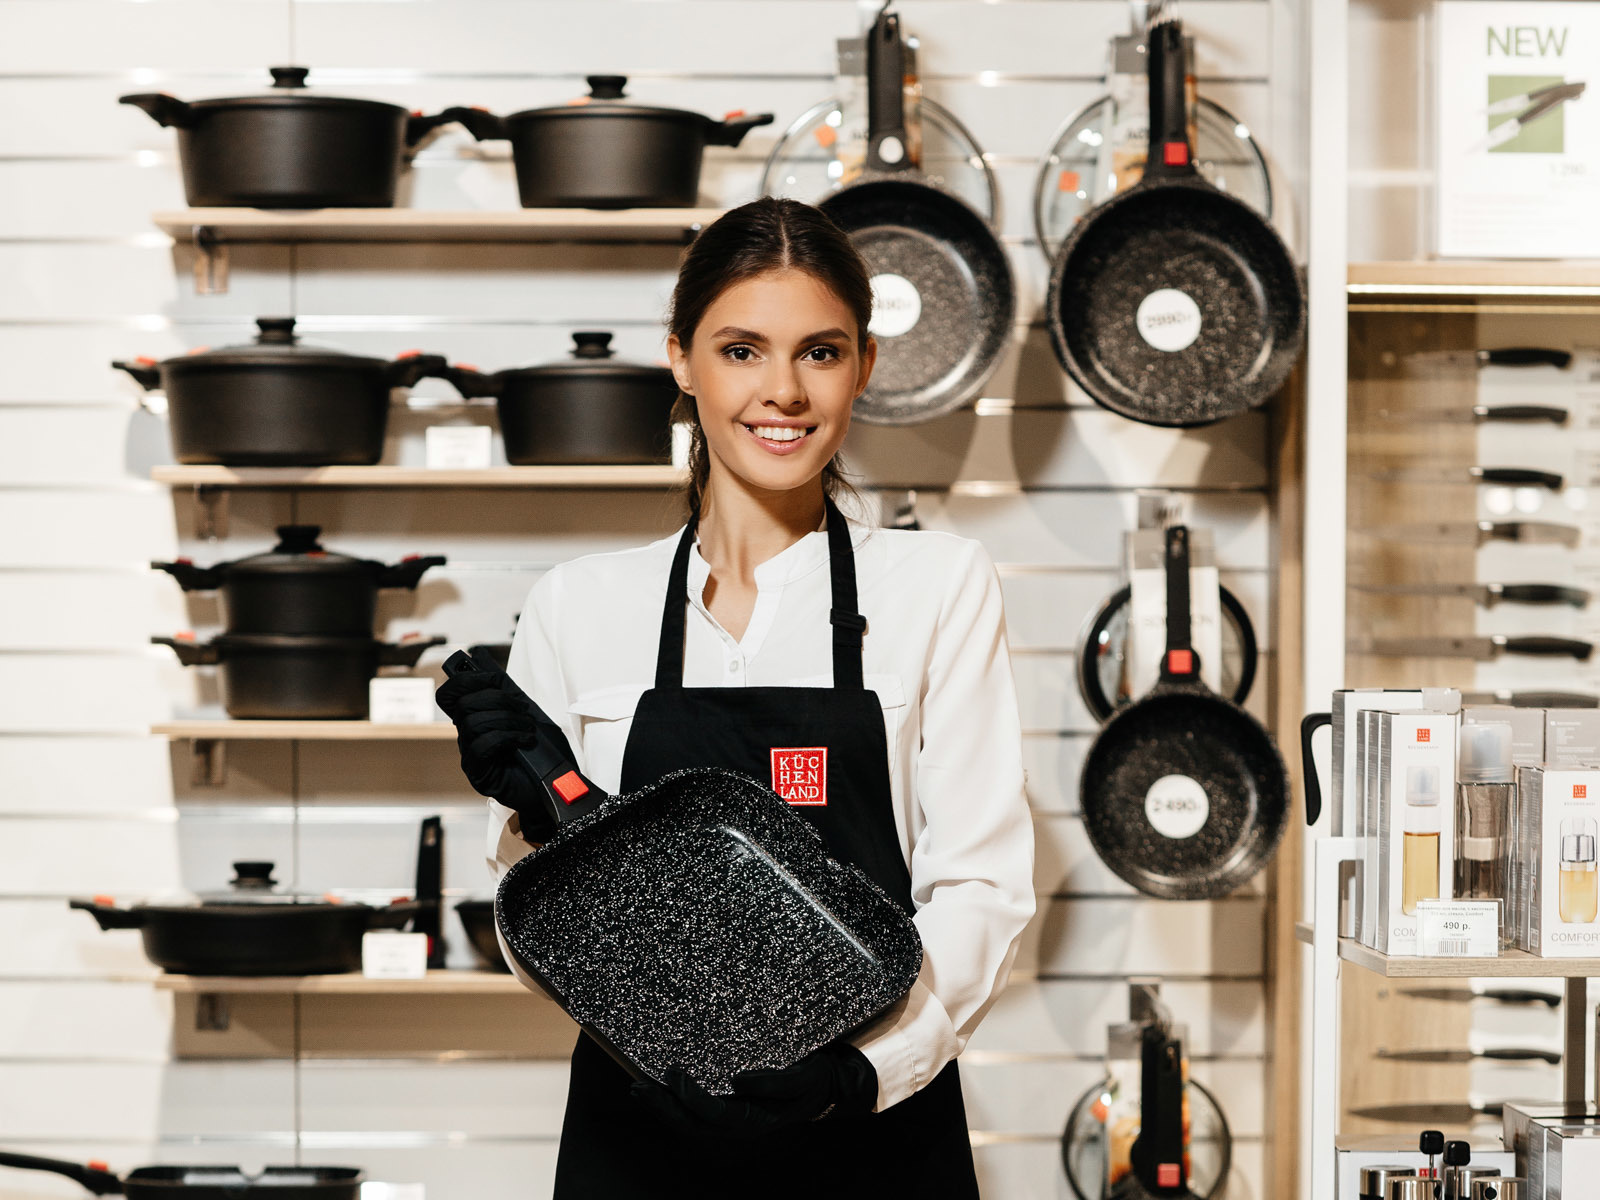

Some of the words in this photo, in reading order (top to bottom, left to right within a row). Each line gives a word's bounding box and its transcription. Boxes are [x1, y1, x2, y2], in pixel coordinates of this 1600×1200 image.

[1486, 26, 1568, 57] NEW
[779, 754, 819, 770] KÜC
[780, 770, 818, 784] HEN
[780, 786, 819, 799] LAND
[1443, 921, 1460, 930] 490
[1551, 932, 1600, 942] COMFOR
